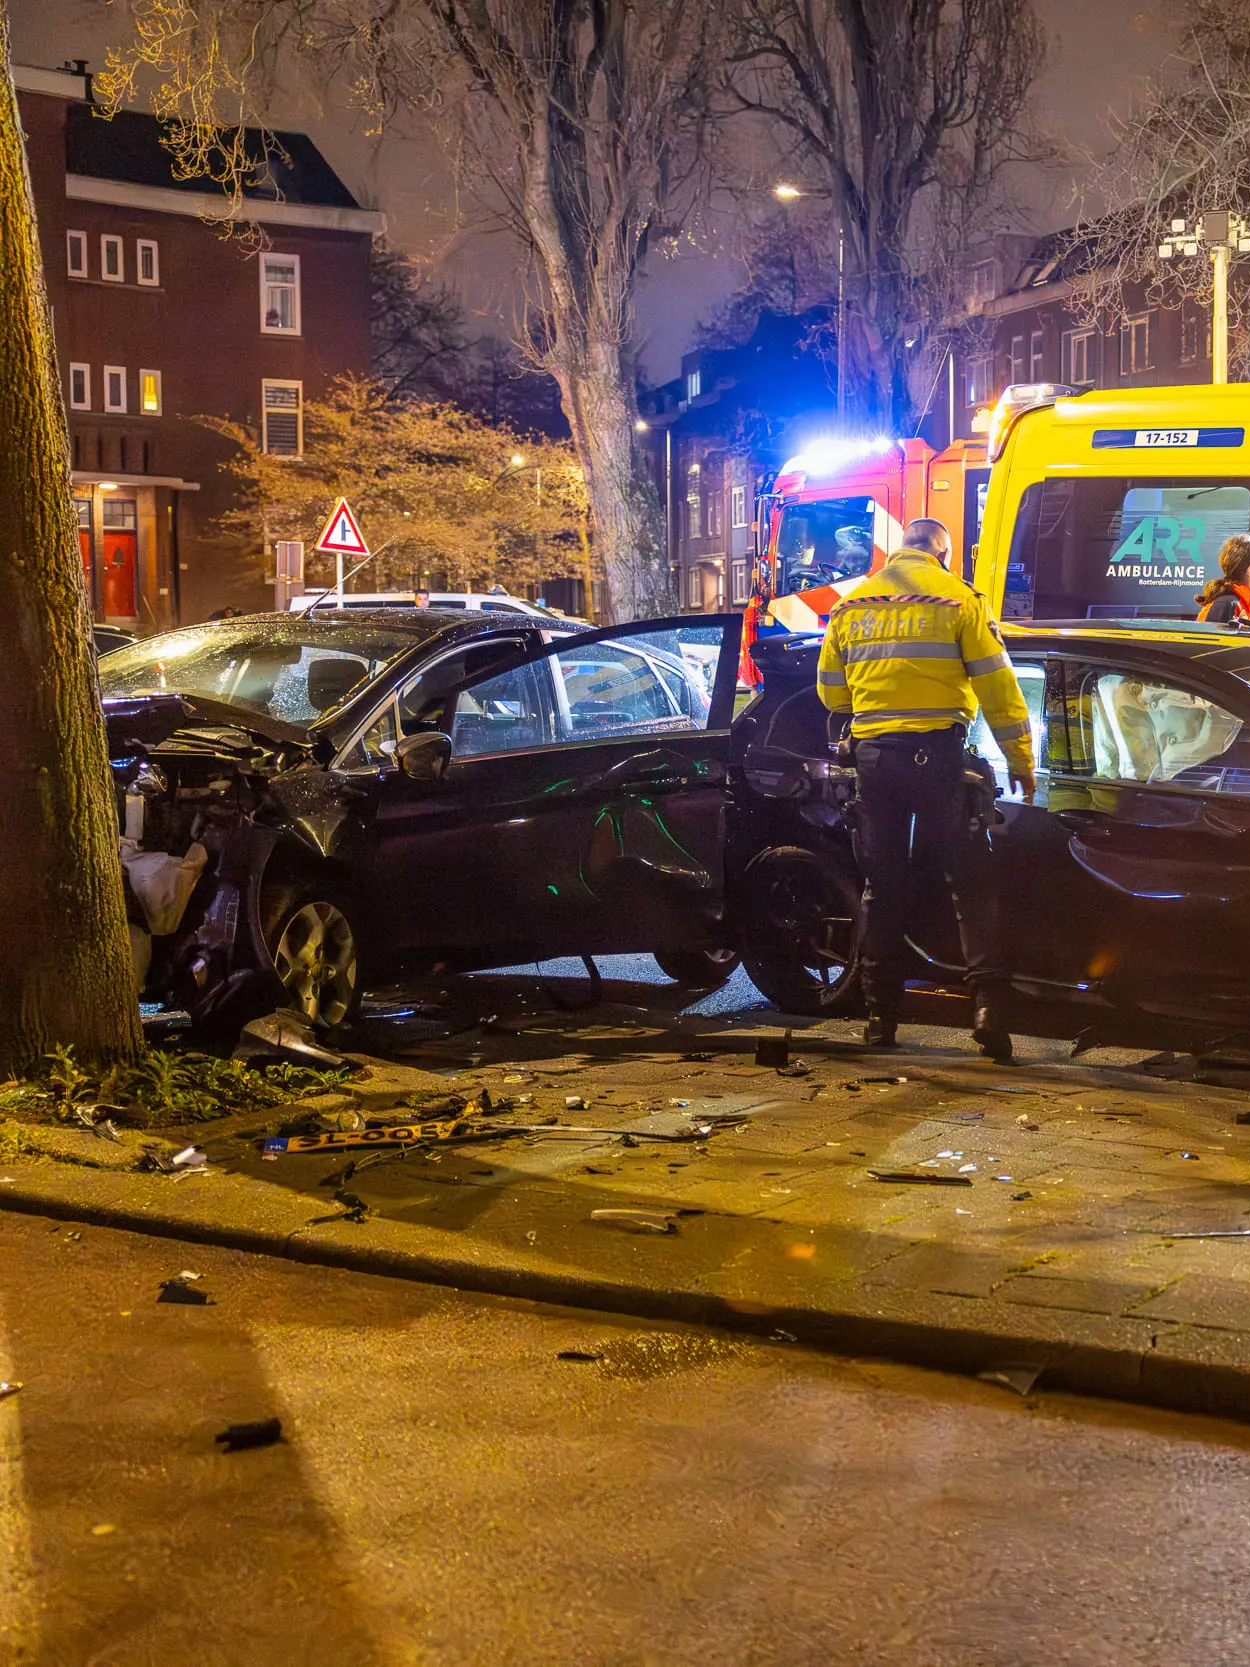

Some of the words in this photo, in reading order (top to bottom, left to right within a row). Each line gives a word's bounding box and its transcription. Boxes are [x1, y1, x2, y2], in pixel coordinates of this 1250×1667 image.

[1145, 432, 1188, 444] 17-152
[1109, 516, 1207, 563] ARR
[1105, 564, 1205, 579] AMBULANCE
[1138, 578, 1204, 587] Rotterdam-Rijnmond
